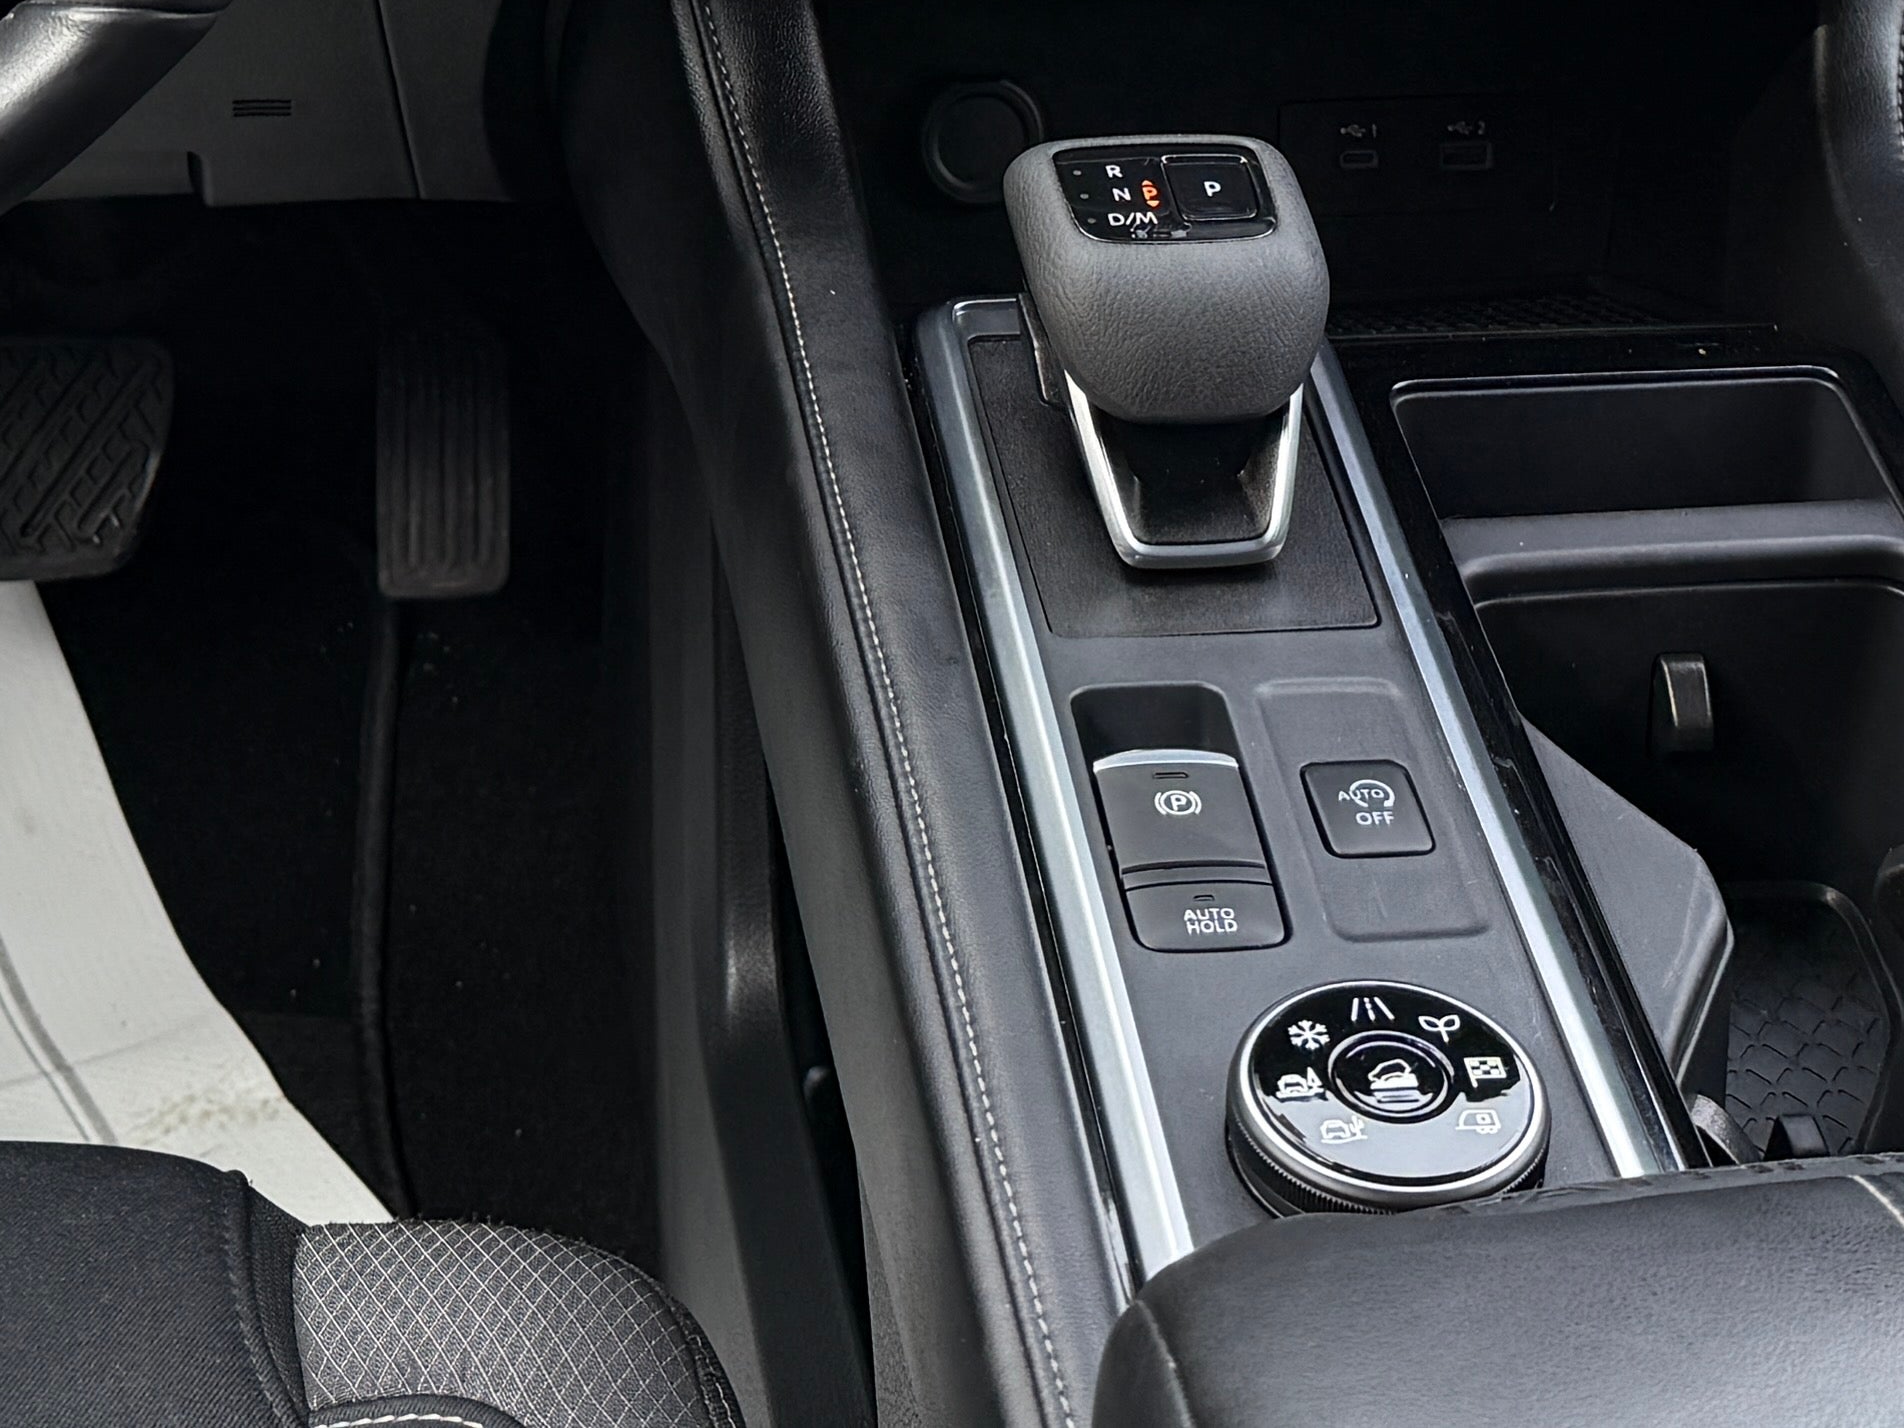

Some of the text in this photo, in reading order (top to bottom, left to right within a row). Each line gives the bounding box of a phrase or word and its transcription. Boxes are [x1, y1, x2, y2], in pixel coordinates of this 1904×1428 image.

[1105, 164, 1123, 179] R
[1112, 188, 1132, 202] N
[1203, 181, 1222, 197] P
[1107, 211, 1159, 227] D/M
[1338, 786, 1385, 802] AUTO
[1356, 810, 1394, 826] OFF
[1184, 907, 1235, 920] AUTO
[1186, 919, 1238, 934] HOLD
